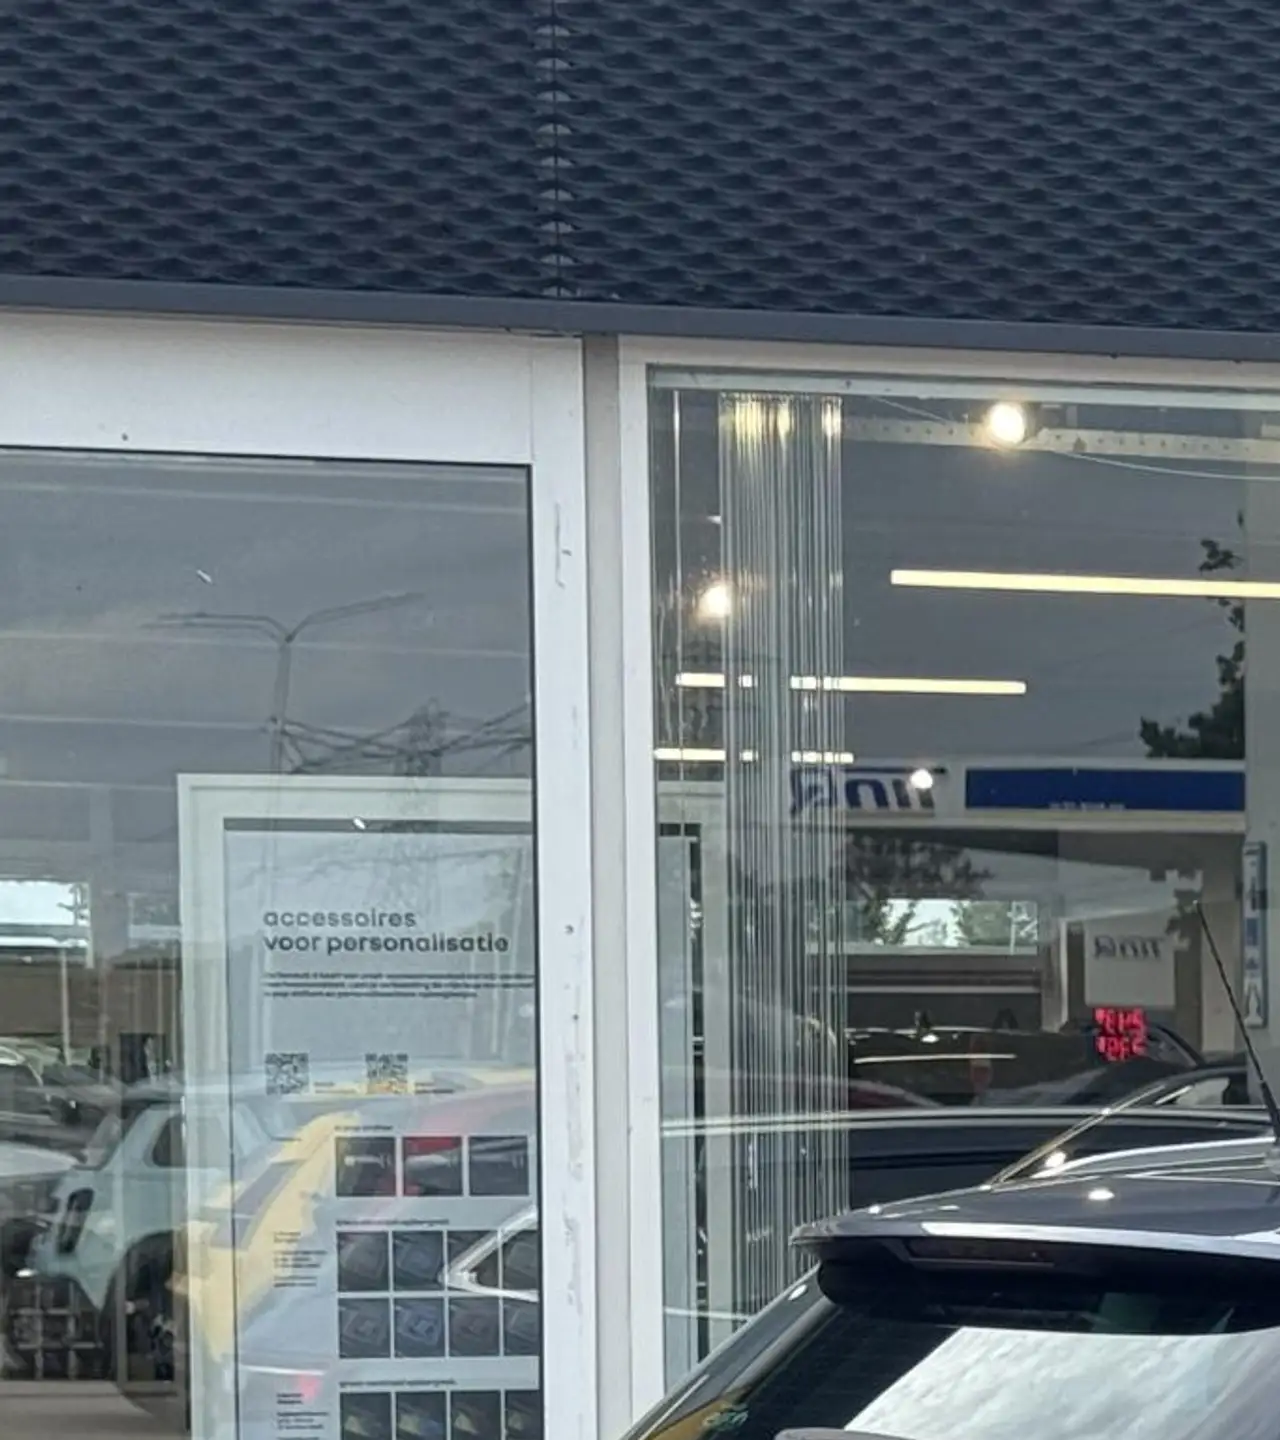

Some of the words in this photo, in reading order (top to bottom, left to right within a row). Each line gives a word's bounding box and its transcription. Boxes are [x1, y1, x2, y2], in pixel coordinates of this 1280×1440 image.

[263, 907, 417, 928] accessoires
[264, 935, 321, 952] voor
[326, 932, 509, 955] personalisatie
